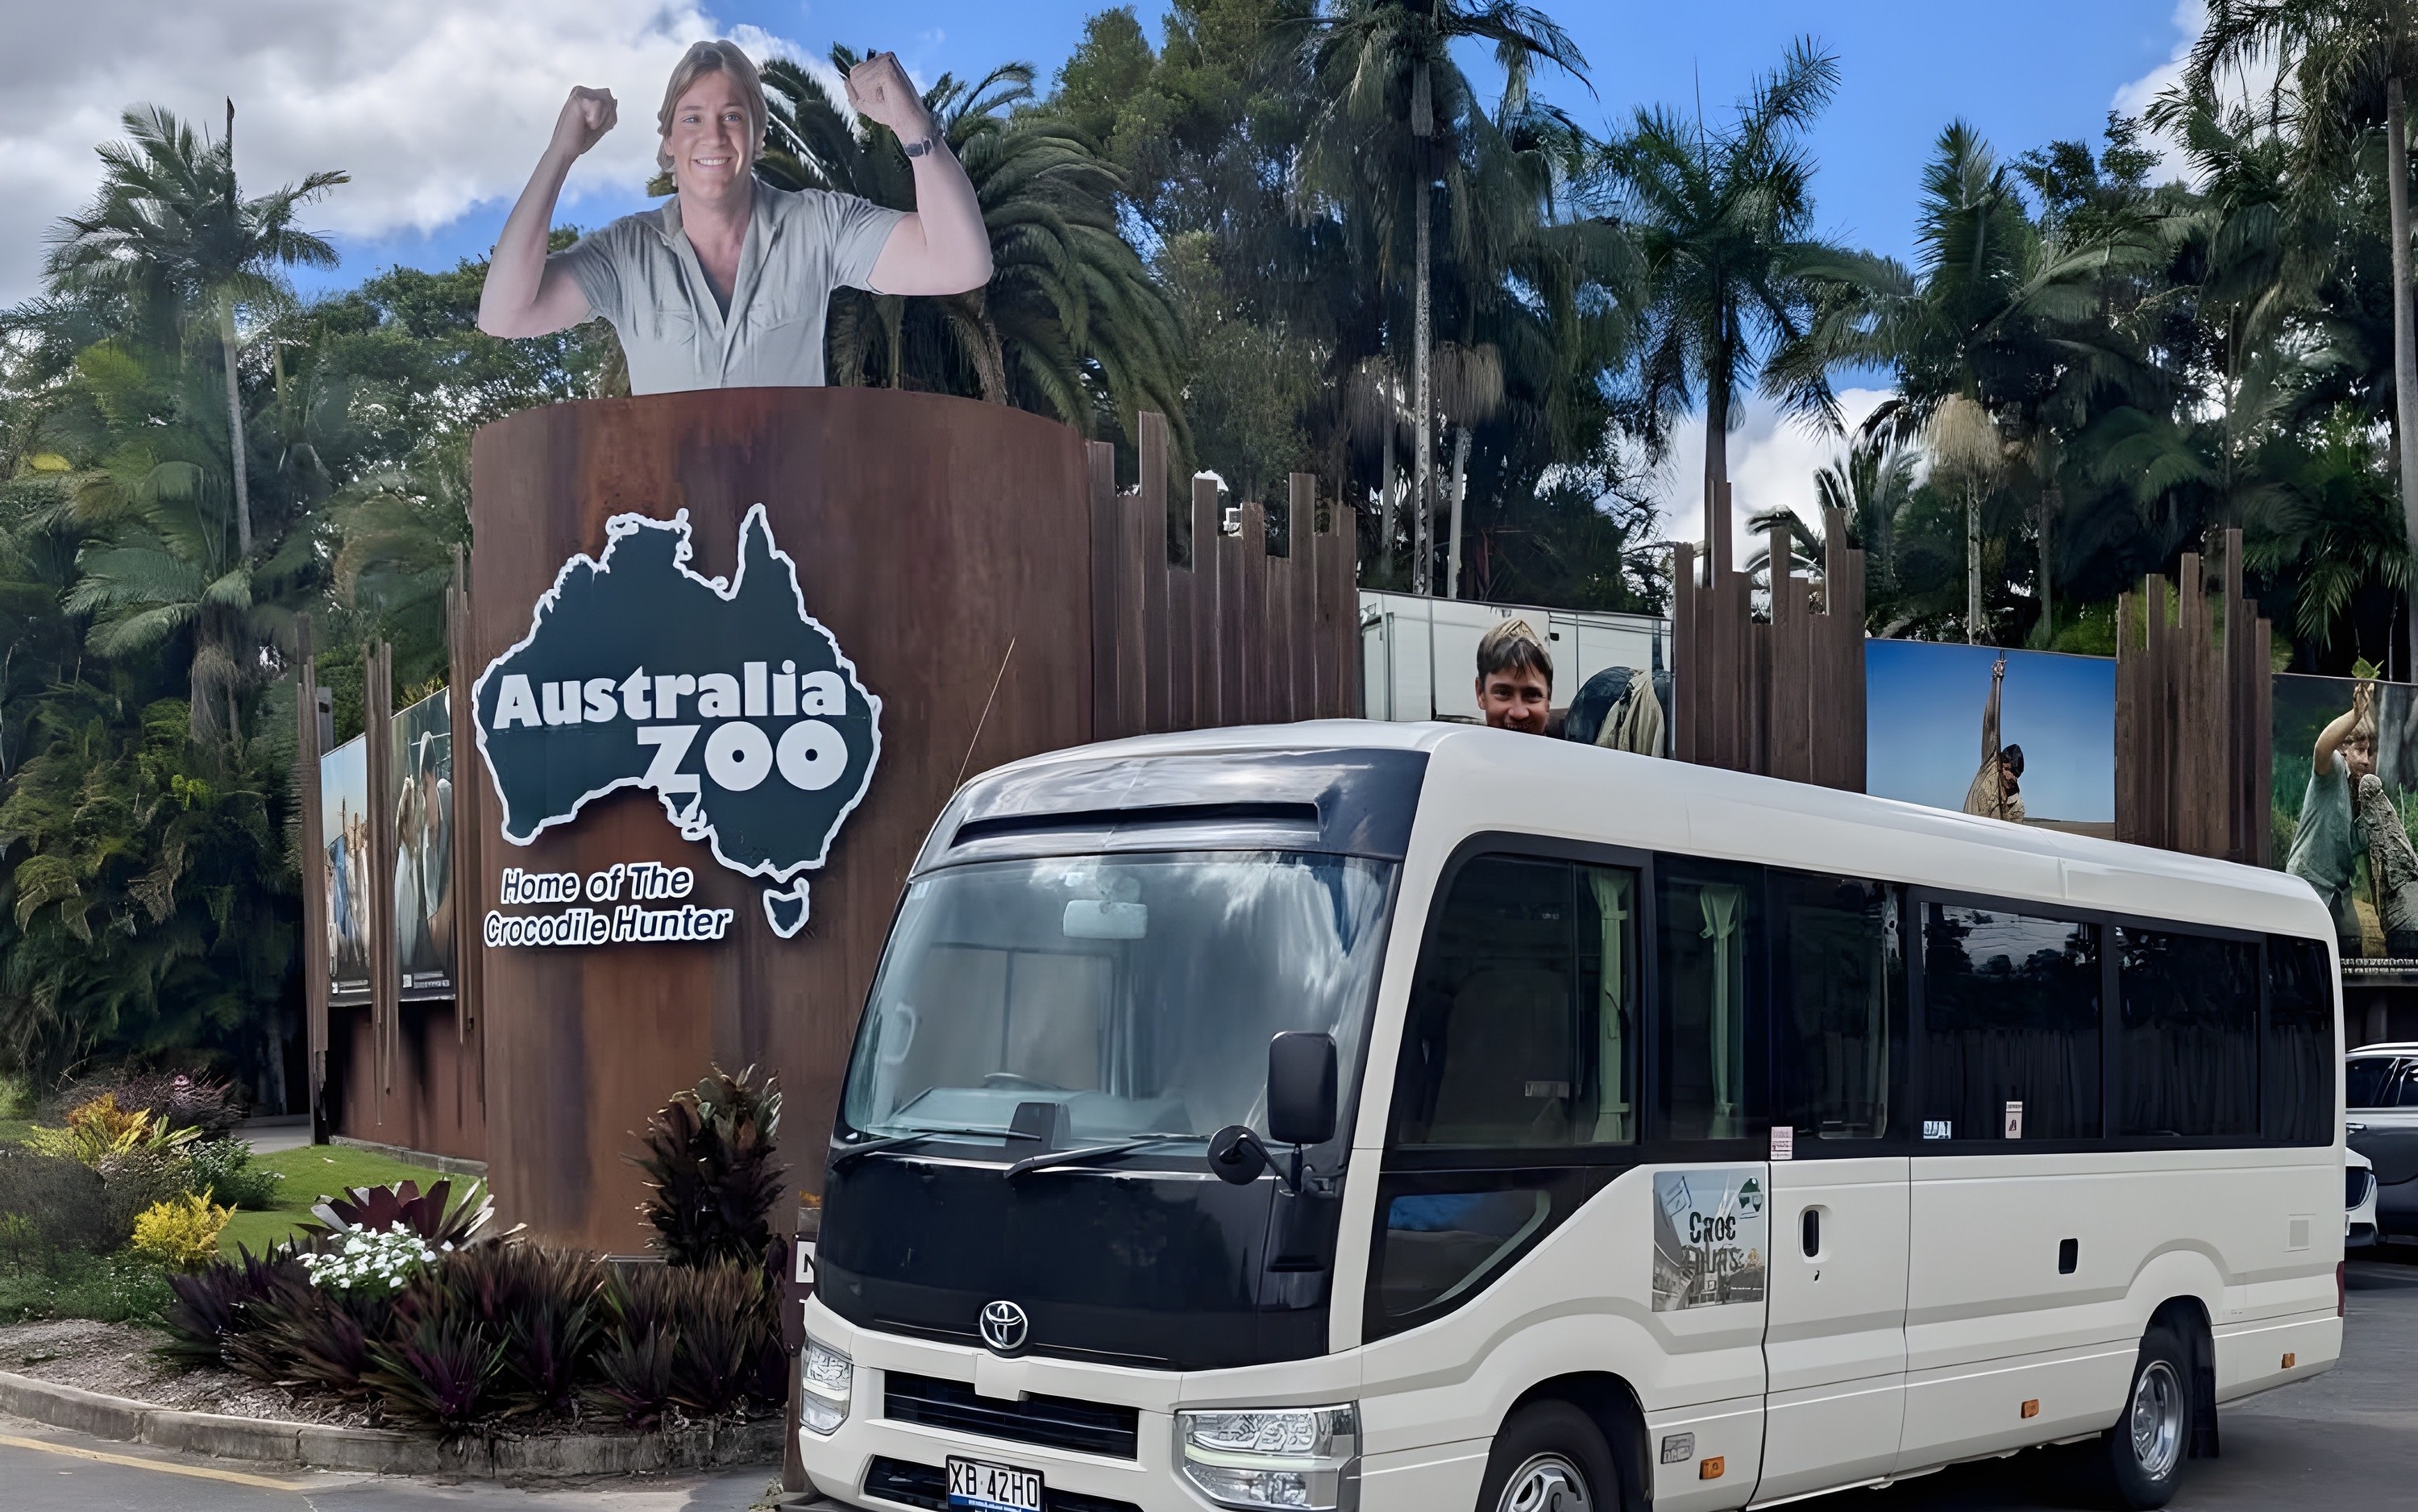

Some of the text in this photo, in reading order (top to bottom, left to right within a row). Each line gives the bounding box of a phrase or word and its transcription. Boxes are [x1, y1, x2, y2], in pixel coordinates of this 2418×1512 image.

[492, 659, 846, 729] Australia
[637, 719, 848, 791] ZOO
[502, 863, 692, 903] Home of The
[485, 906, 731, 945] Crocodile Hunter
